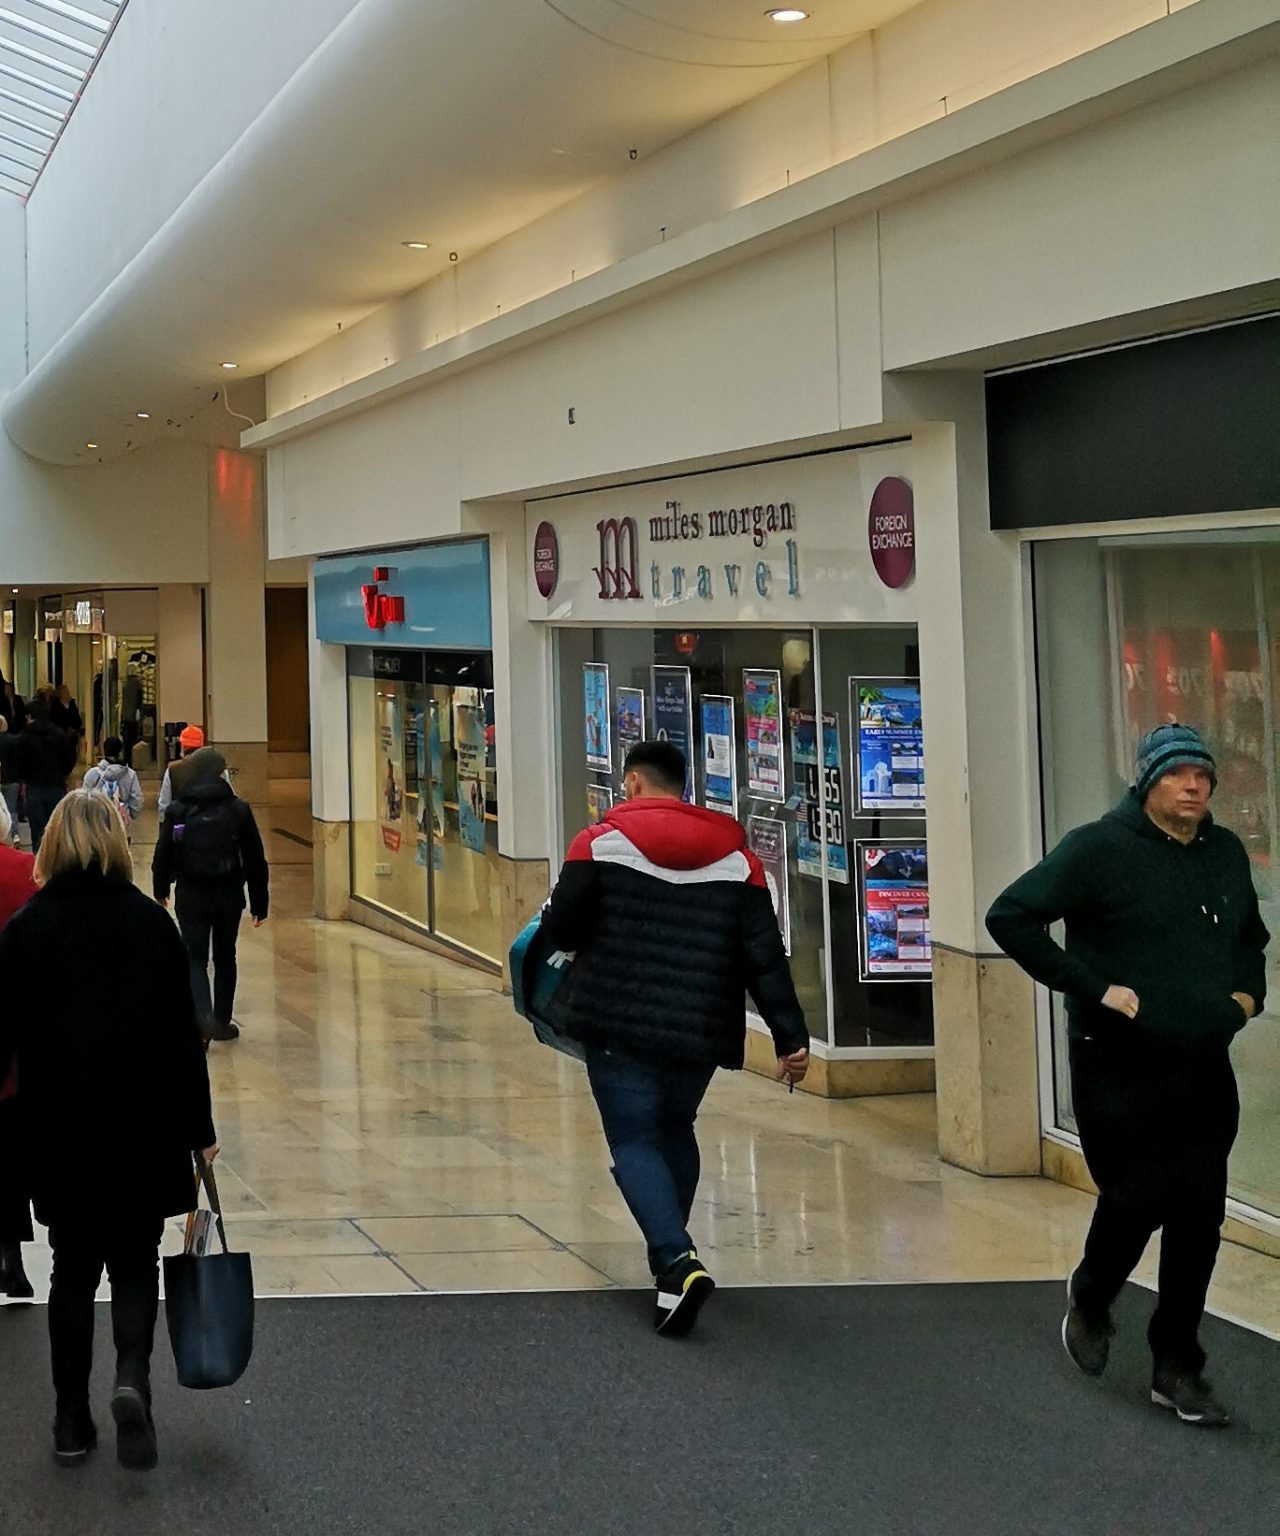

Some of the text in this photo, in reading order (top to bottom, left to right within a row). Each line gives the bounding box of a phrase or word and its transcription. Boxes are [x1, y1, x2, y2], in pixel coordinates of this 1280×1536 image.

[648, 501, 795, 548] miles morgan
[875, 514, 908, 531] FOREIGN
[872, 532, 913, 550] EXCHANGE
[650, 538, 800, 599] travel
